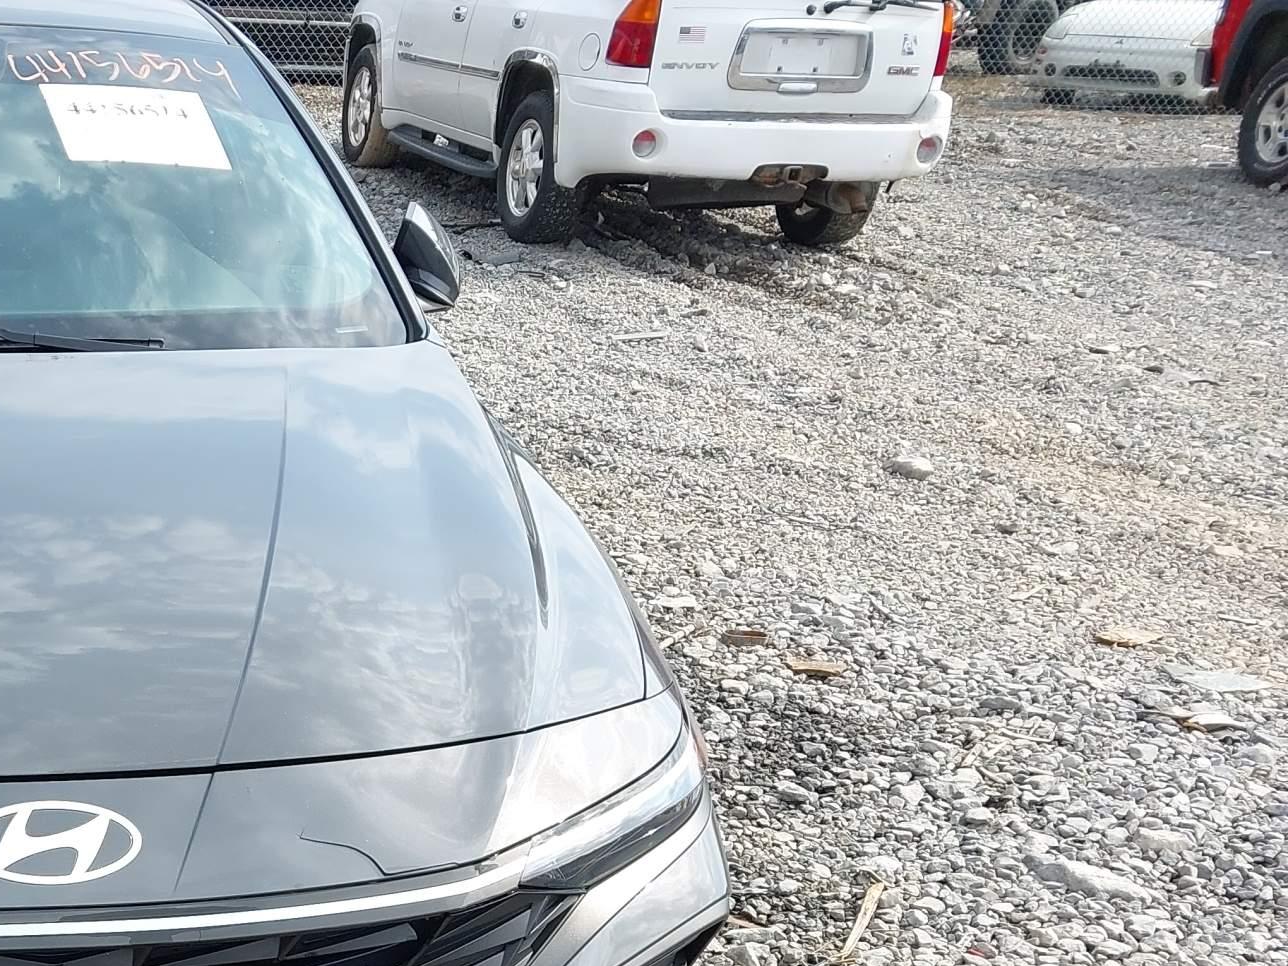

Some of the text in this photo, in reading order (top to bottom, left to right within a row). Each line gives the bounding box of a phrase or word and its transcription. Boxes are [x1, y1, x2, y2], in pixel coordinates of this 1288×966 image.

[661, 62, 720, 70] ENVOY
[887, 65, 921, 76] GMC
[7, 50, 242, 101] 44156514
